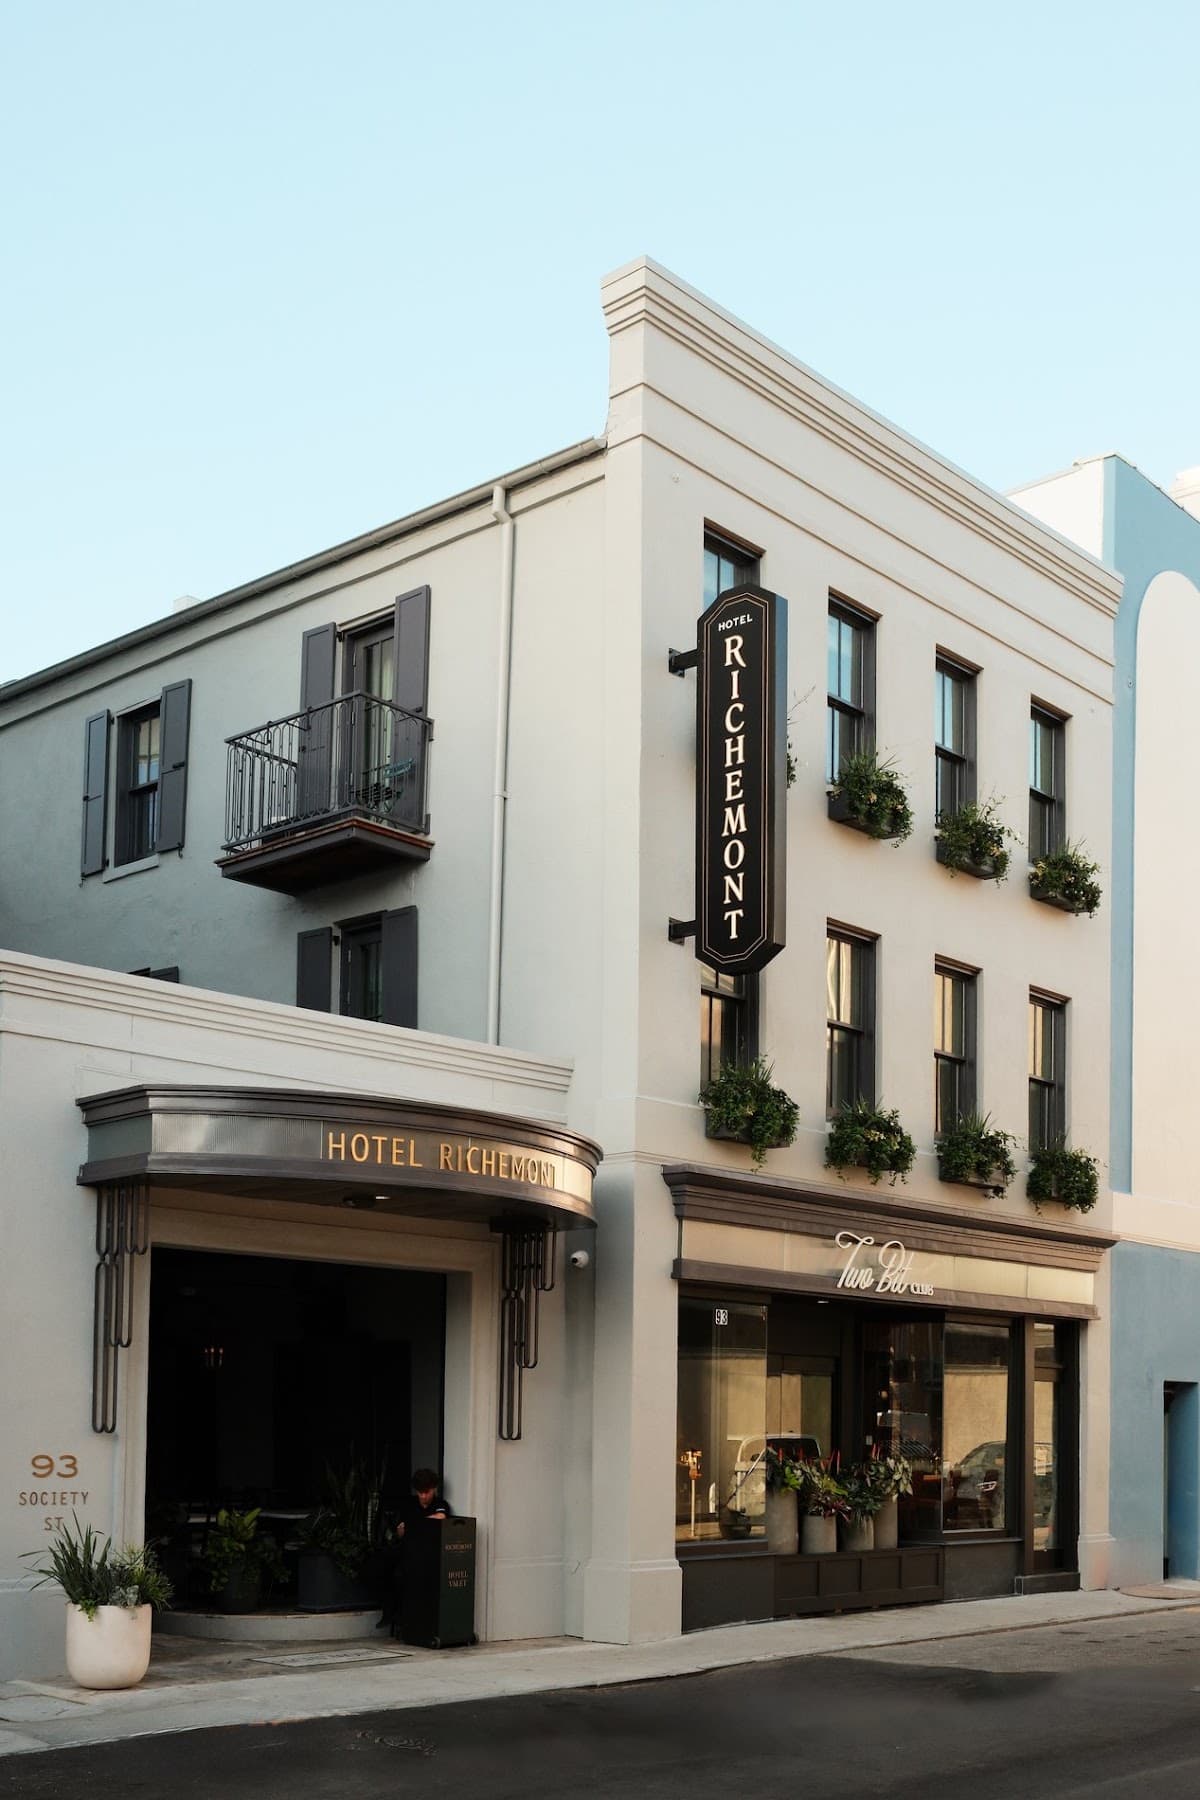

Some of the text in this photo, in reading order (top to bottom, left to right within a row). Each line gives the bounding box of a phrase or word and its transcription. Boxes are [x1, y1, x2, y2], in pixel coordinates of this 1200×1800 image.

[718, 613, 753, 632] HOTEL
[721, 634, 748, 940] RICHEMONT
[328, 1131, 557, 1190] HOTEL RICHEMONT
[835, 1231, 934, 1297] Two Bit CLUB
[716, 1309, 727, 1325] 93
[31, 1454, 78, 1479] 93
[18, 1491, 89, 1506] SOCIETY
[44, 1516, 64, 1531] ST
